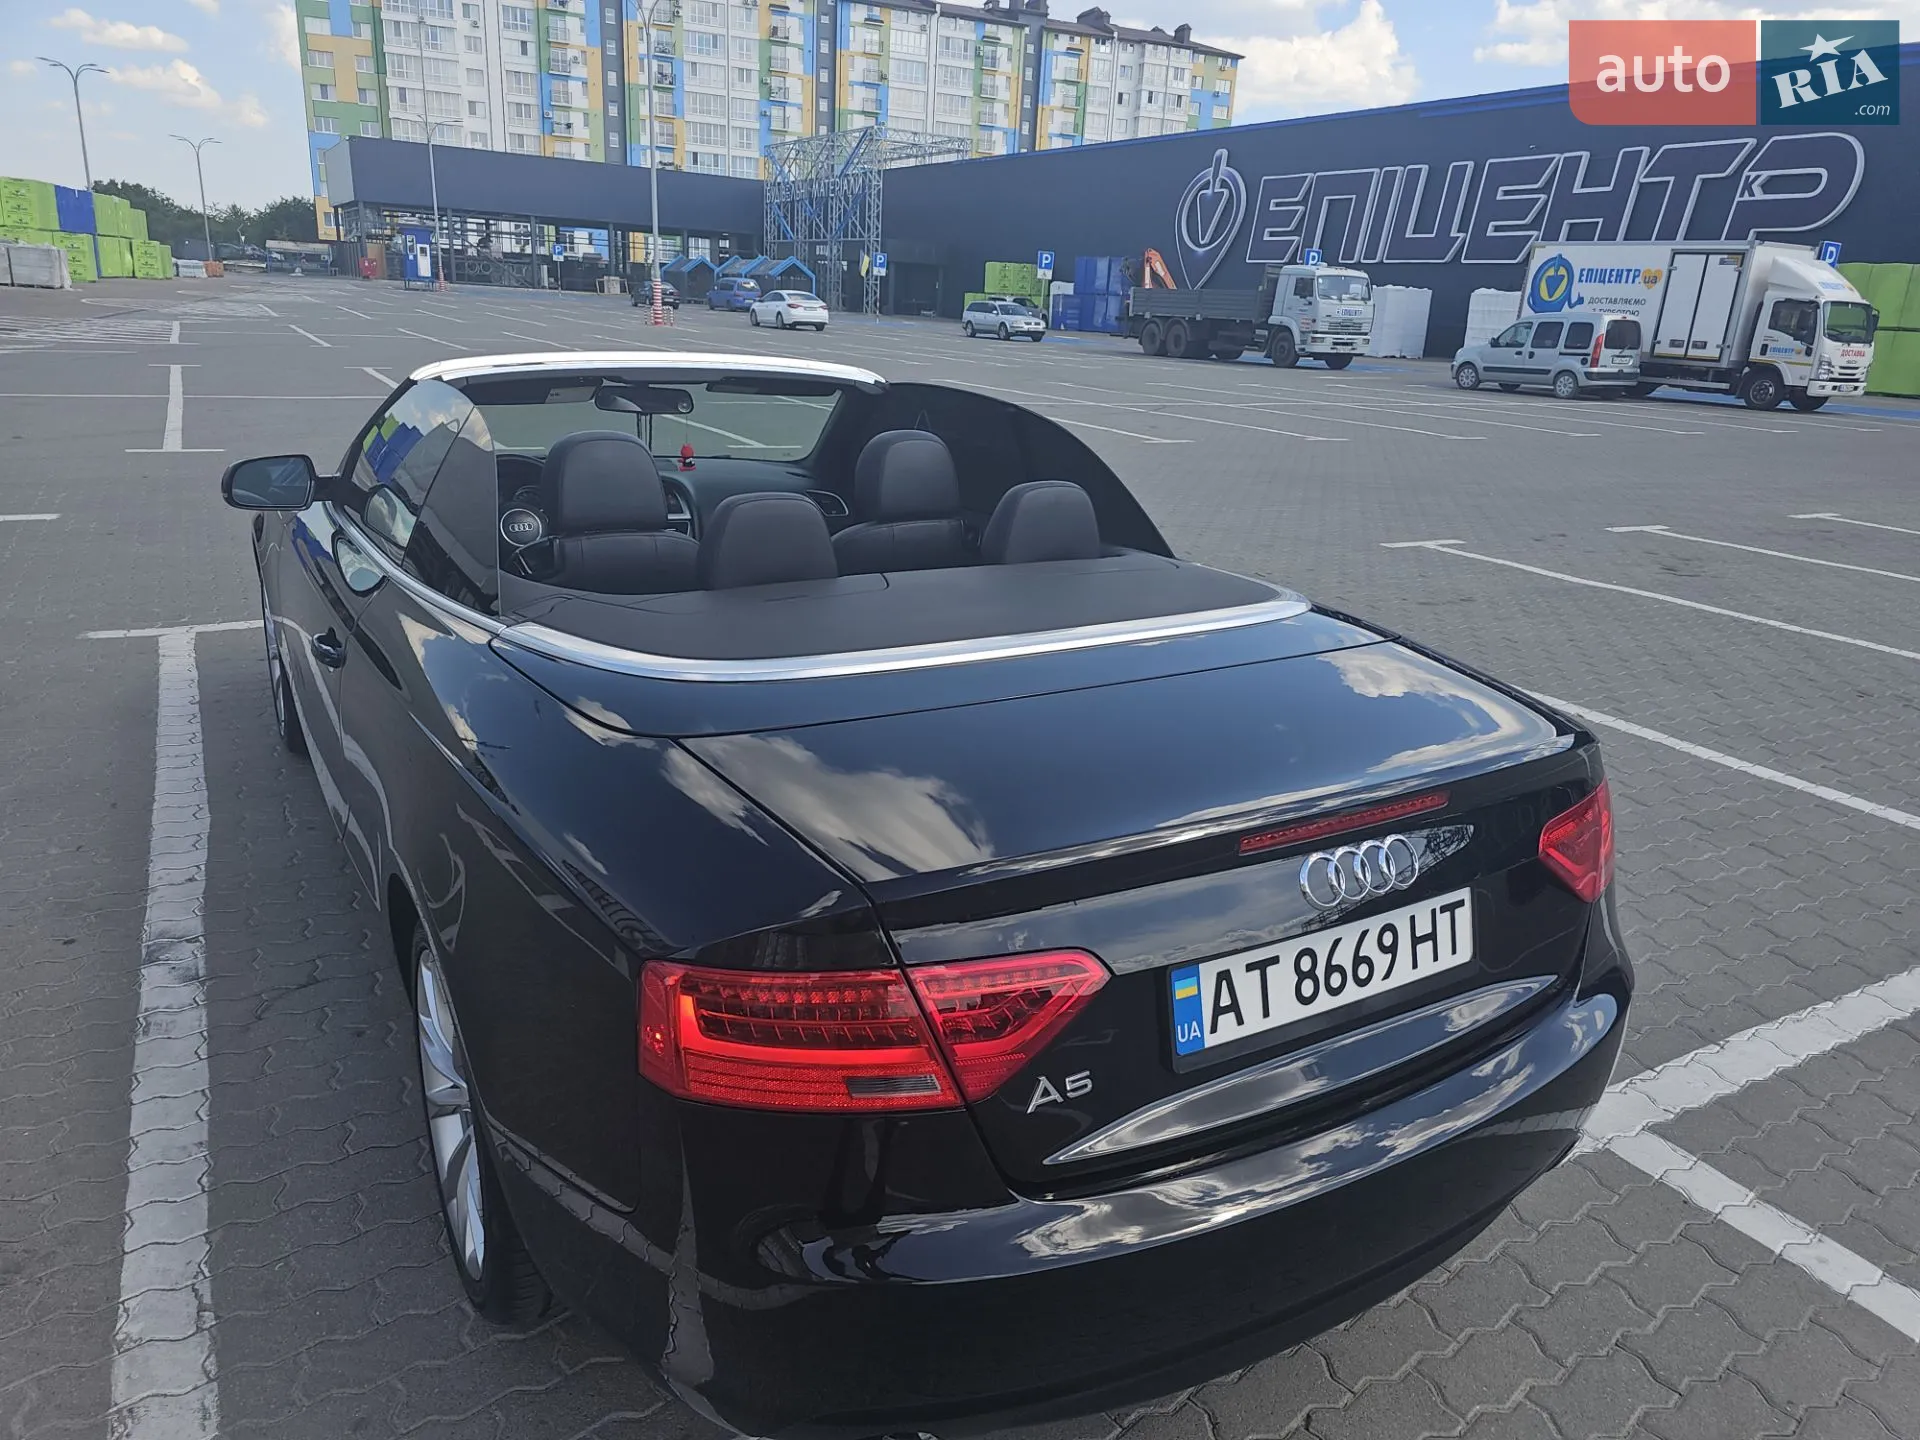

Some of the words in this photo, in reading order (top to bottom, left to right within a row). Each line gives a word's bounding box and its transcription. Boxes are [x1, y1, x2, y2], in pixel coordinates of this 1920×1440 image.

[1246, 132, 1865, 264] ЕПІЦЕНТР
[555, 245, 562, 255] P
[876, 256, 886, 269] P
[1041, 253, 1052, 268] P
[1309, 251, 1319, 265] P
[1588, 296, 1646, 306] ДОСТАВЛЯЄМО
[1210, 954, 1281, 1034] AT
[1293, 921, 1400, 1006] 8669
[1408, 898, 1466, 971] HT
[1177, 1020, 1202, 1042] UA
[1026, 1069, 1094, 1115] A5
